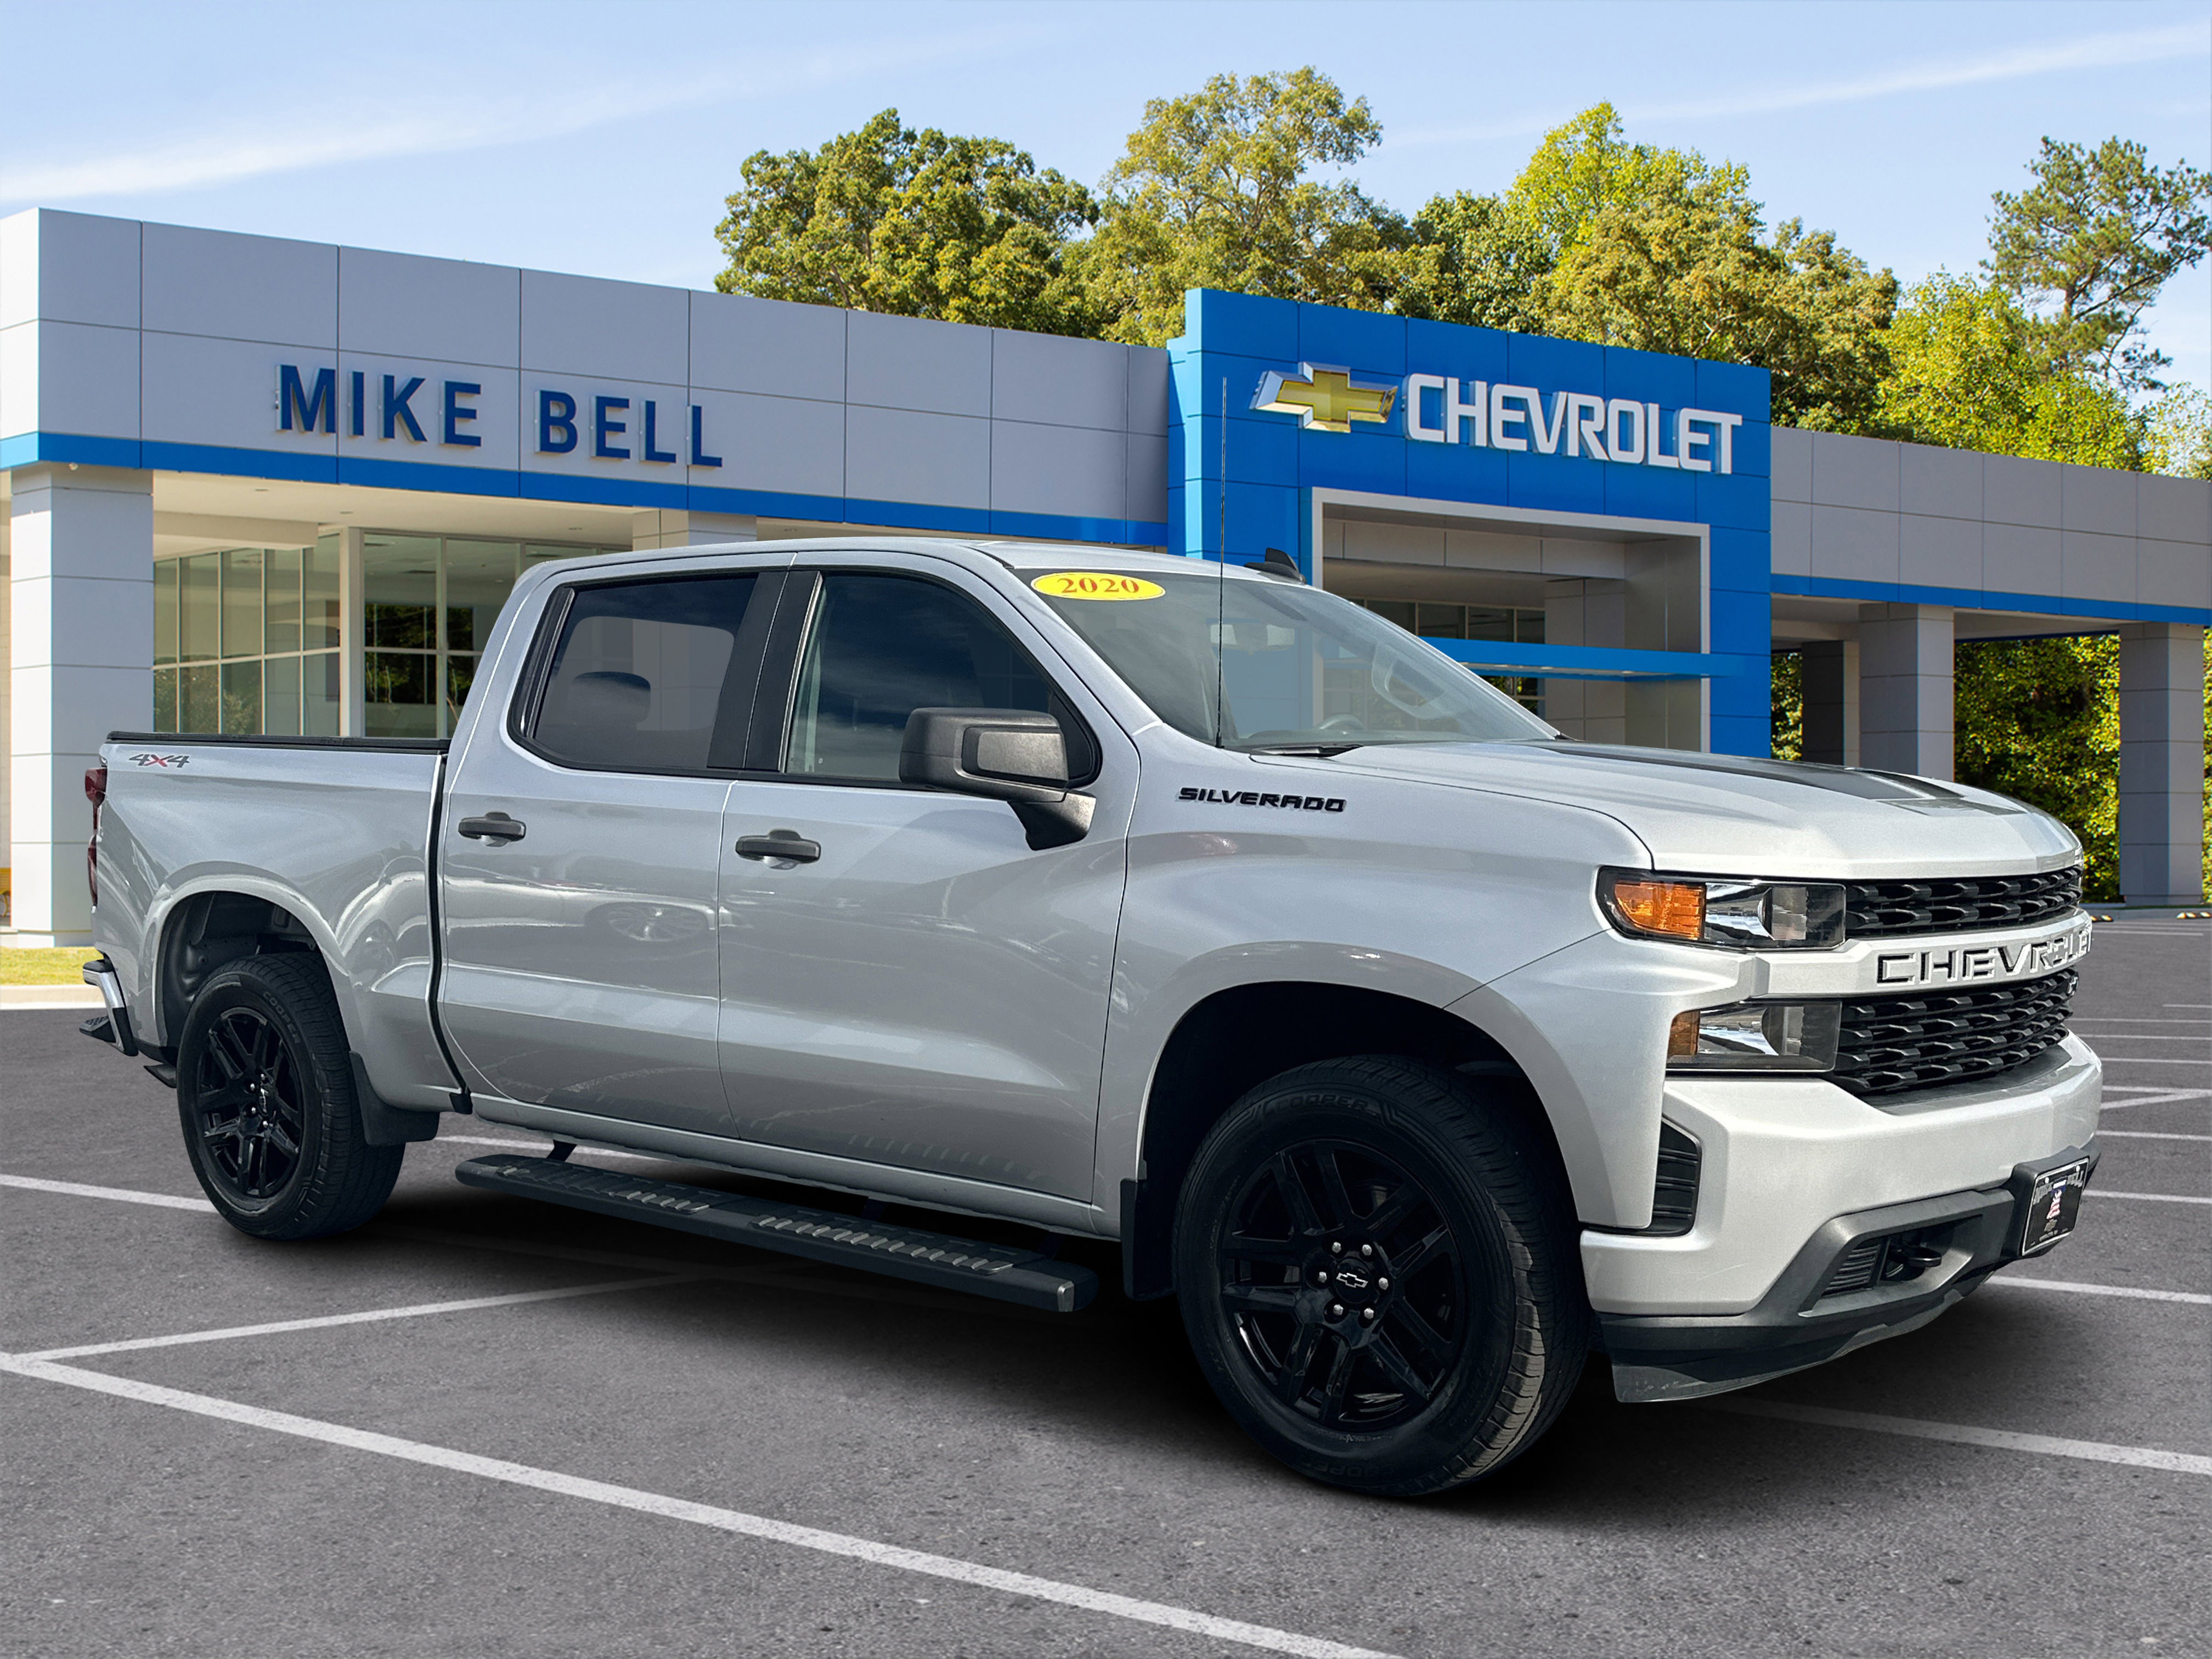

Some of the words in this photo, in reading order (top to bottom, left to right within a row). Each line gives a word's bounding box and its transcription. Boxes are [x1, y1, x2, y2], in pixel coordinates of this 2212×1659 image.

[277, 364, 482, 447] MIKE
[534, 389, 723, 467] BELL
[1404, 373, 1743, 475] CHEVROLET
[1057, 577, 1139, 593] 2020
[1178, 787, 1347, 812] SILVERADO
[263, 991, 301, 1043] COOPER
[1276, 1093, 1369, 1111] COOPER
